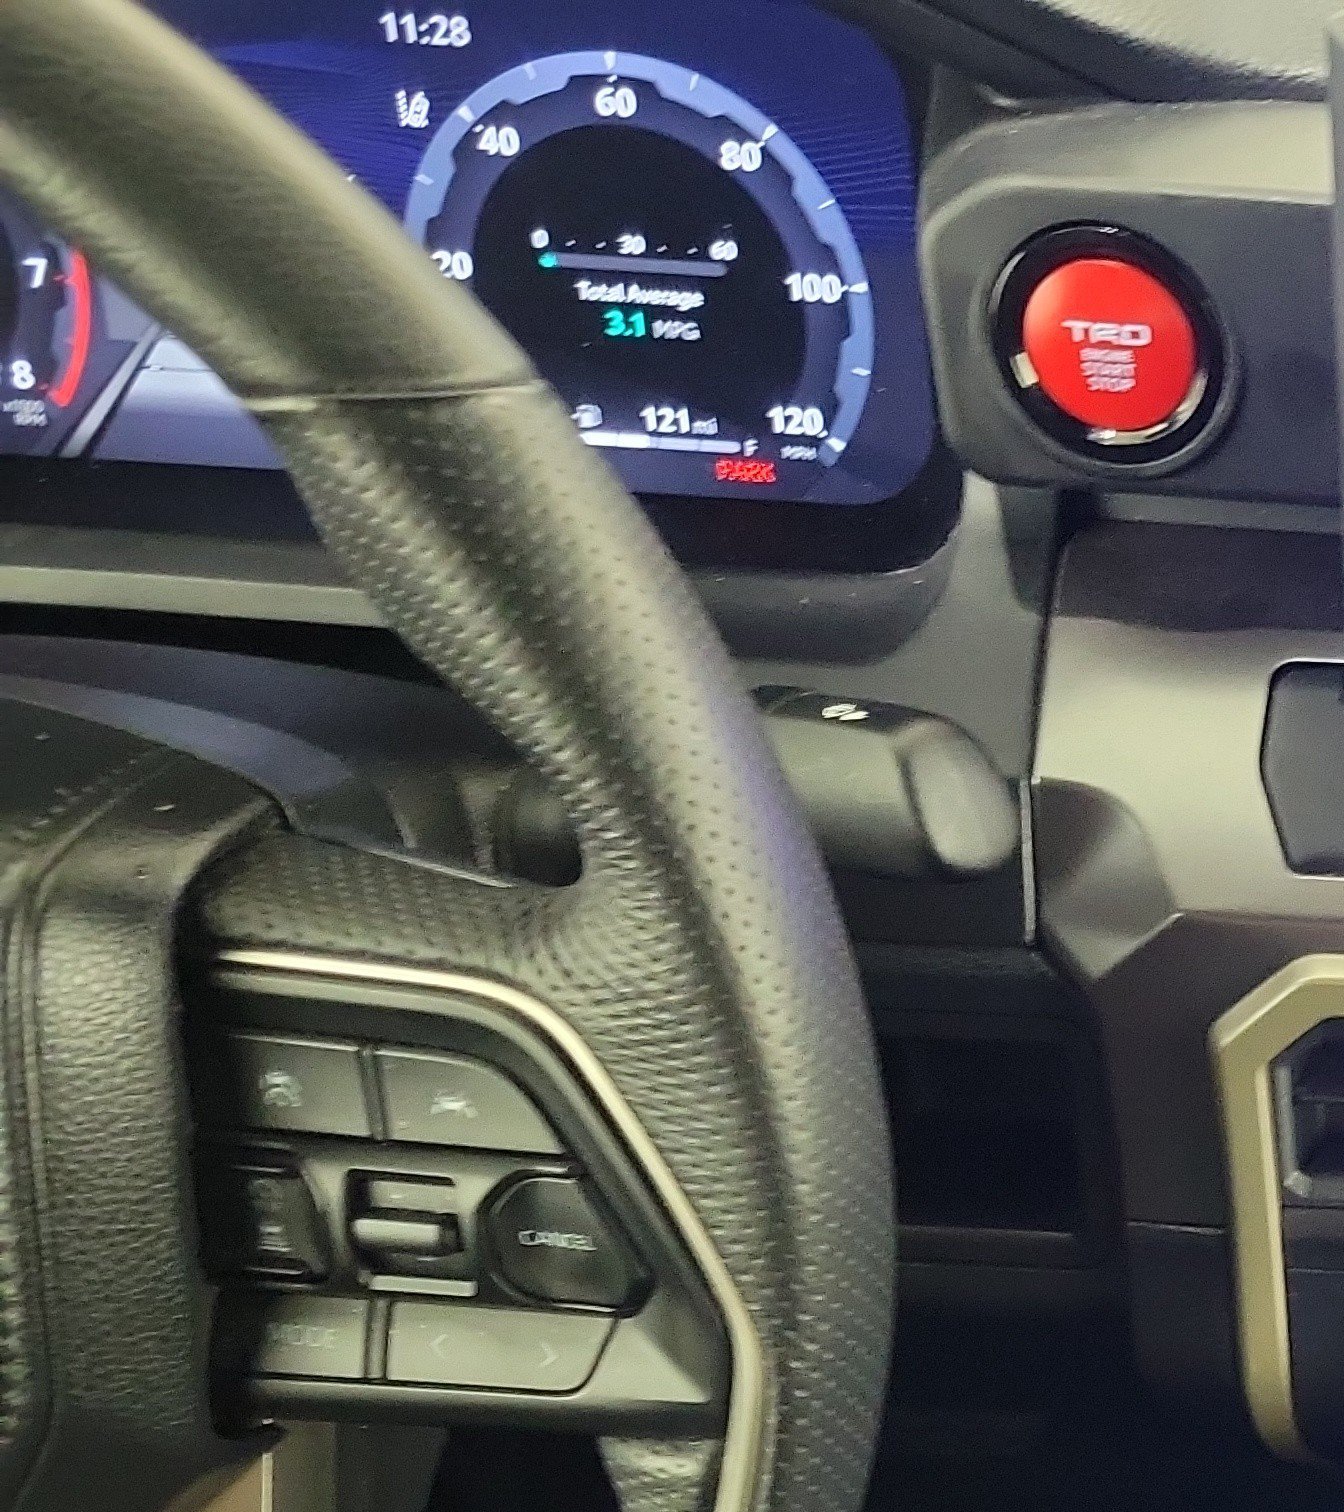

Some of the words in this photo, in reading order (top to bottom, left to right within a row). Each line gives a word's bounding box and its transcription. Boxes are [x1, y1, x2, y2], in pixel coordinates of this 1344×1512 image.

[379, 11, 473, 48] 11:28
[593, 87, 638, 119] 60
[476, 125, 521, 157] 40
[719, 140, 763, 172] 80
[530, 227, 550, 249] 0
[615, 233, 647, 255] 30
[708, 239, 740, 262] 60
[22, 256, 49, 289] 7
[430, 249, 474, 281] 20
[573, 279, 626, 302] Total
[626, 283, 705, 312] Average
[783, 271, 843, 303] 100
[603, 309, 646, 338] 3.1
[652, 318, 702, 341] MPG
[1060, 319, 1153, 347] TRD
[11, 359, 37, 390] 8
[639, 405, 690, 434] 121
[765, 405, 824, 437] 120
[742, 437, 759, 458] F
